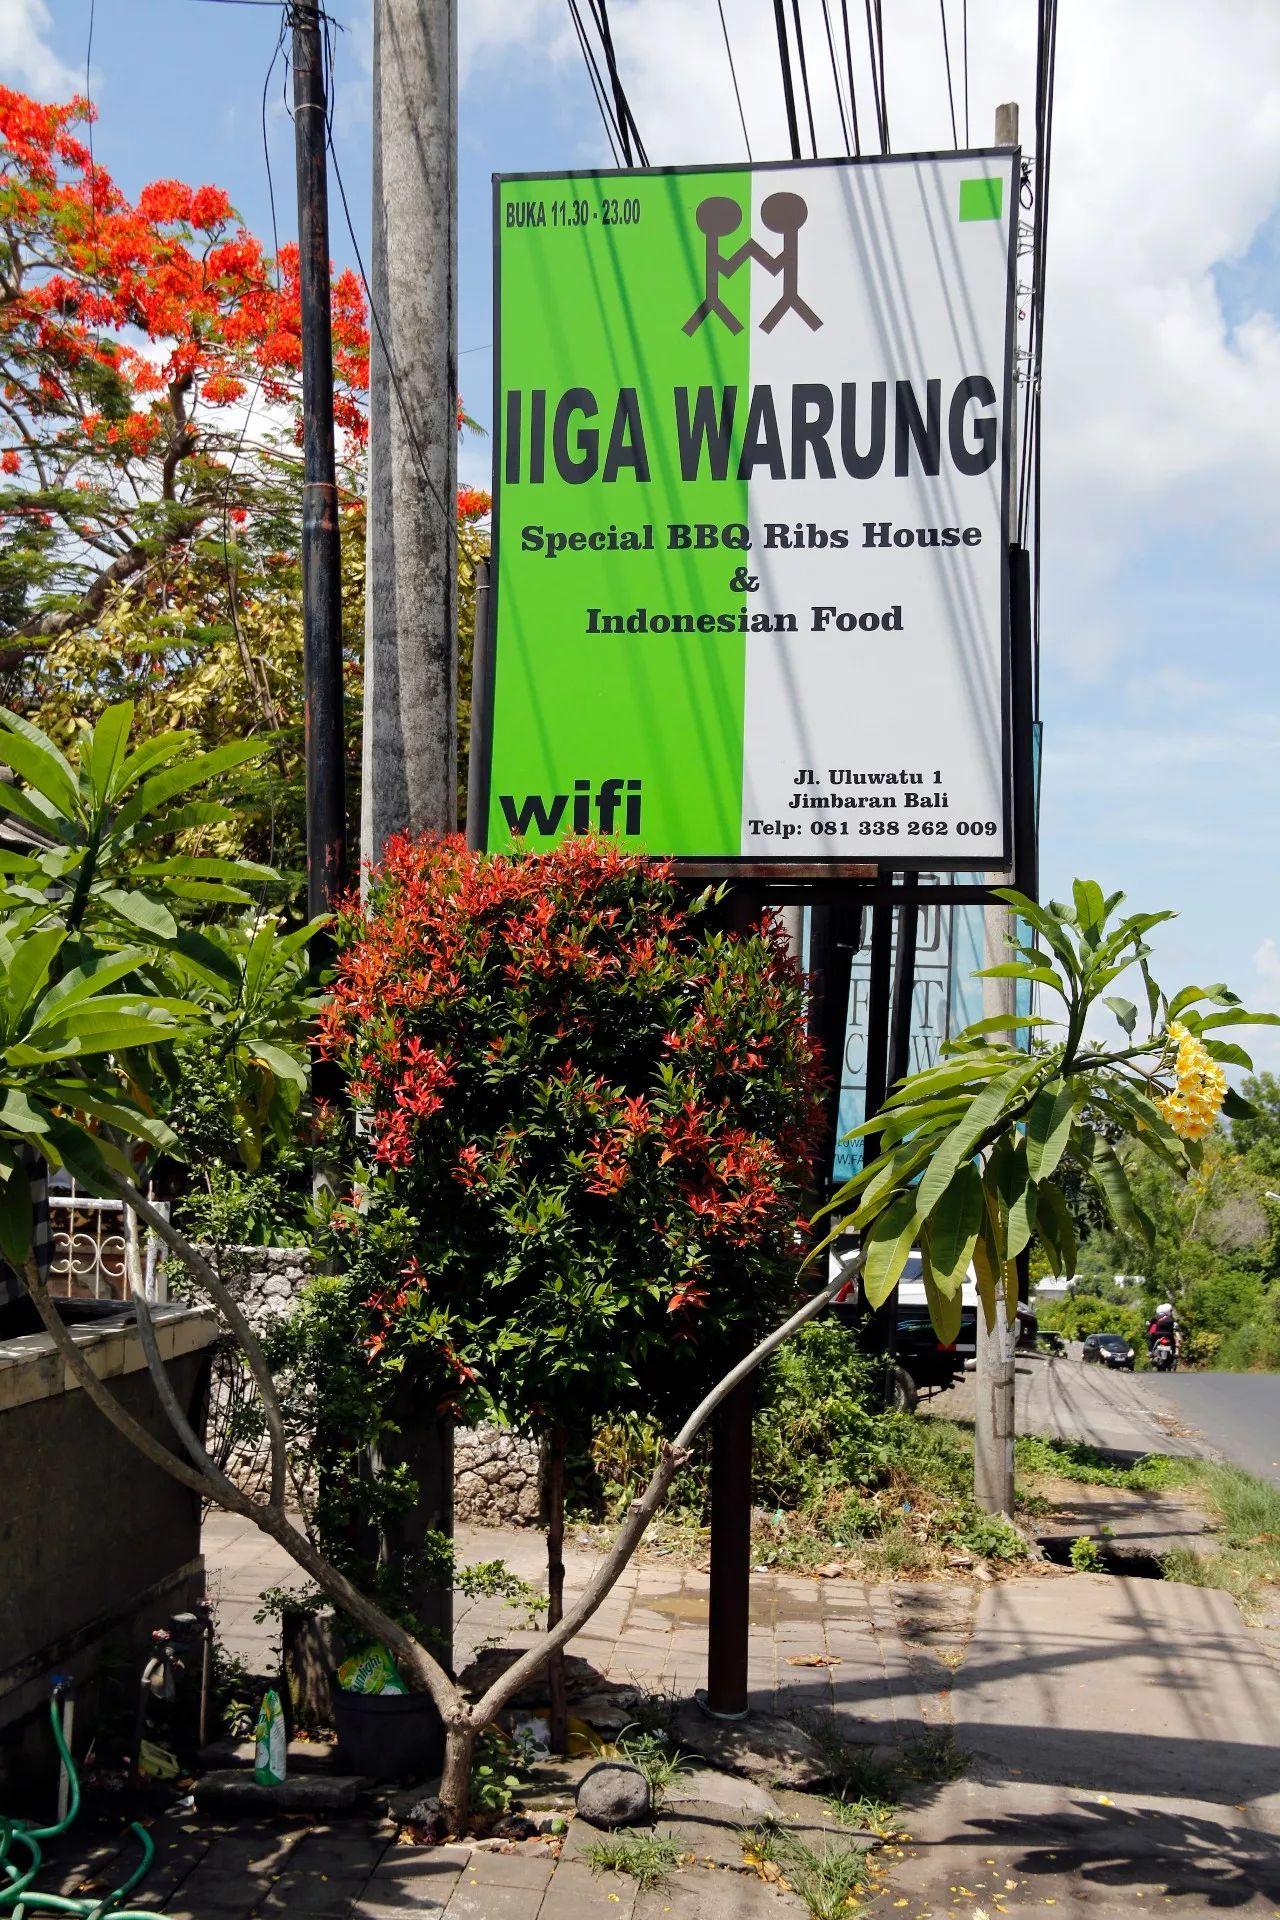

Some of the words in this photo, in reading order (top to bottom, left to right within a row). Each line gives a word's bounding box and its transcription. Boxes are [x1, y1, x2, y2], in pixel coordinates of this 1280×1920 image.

[506, 202, 547, 228] BUKA
[552, 200, 589, 226] 11.30
[602, 199, 641, 225] 23.00
[505, 386, 652, 485] IIGA
[673, 375, 998, 482] WARUNG
[520, 525, 655, 558] Special
[666, 523, 753, 551] BBQ
[763, 522, 849, 549] Ribs
[862, 522, 982, 548] House
[729, 566, 760, 593] &
[585, 607, 799, 634] Indonesian
[810, 605, 904, 632] Food
[793, 769, 821, 785] Jl.
[828, 769, 924, 785] Uluwatu
[933, 770, 943, 784] 1
[498, 778, 642, 836] wifi
[788, 793, 897, 809] Jimbaran
[903, 792, 949, 808] Bali
[748, 819, 802, 840] Telp:
[810, 821, 849, 836] 081
[858, 821, 900, 836] 338
[907, 821, 949, 836] 262
[955, 821, 997, 836] 009
[849, 978, 944, 1029] FT
